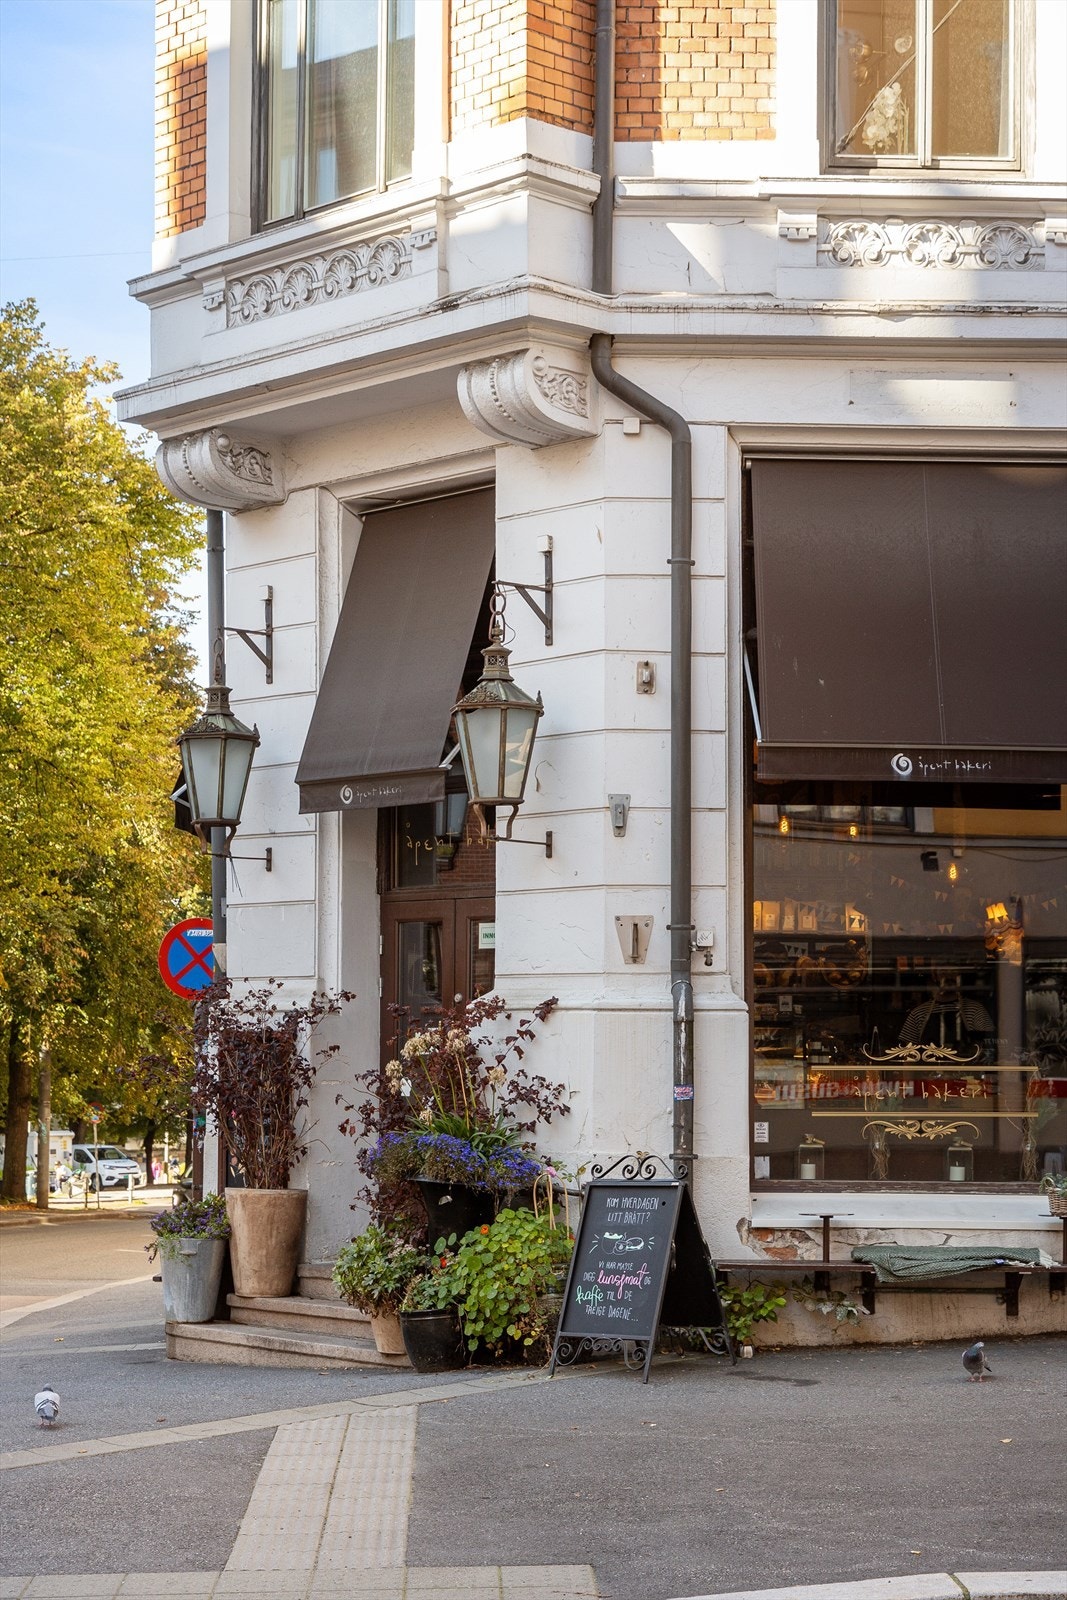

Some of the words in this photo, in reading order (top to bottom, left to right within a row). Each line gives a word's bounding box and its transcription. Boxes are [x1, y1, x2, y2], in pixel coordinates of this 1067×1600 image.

[918, 756, 951, 776] åpent
[955, 759, 992, 772] bakeri
[921, 1081, 987, 1102] bakeri
[606, 1197, 619, 1208] KOM
[621, 1197, 660, 1210] HVERDAGEN
[607, 1212, 623, 1223] LITT
[623, 1211, 651, 1225] BRÅTT?
[605, 1261, 616, 1269] HAR
[617, 1262, 634, 1270] MASSE
[583, 1271, 597, 1282] DIGG
[597, 1263, 650, 1299] lunsjmat
[643, 1276, 652, 1285] OG
[575, 1284, 604, 1307] kaffe
[606, 1291, 616, 1301] TIL
[624, 1290, 633, 1301] DE
[585, 1304, 606, 1316] TREIGE
